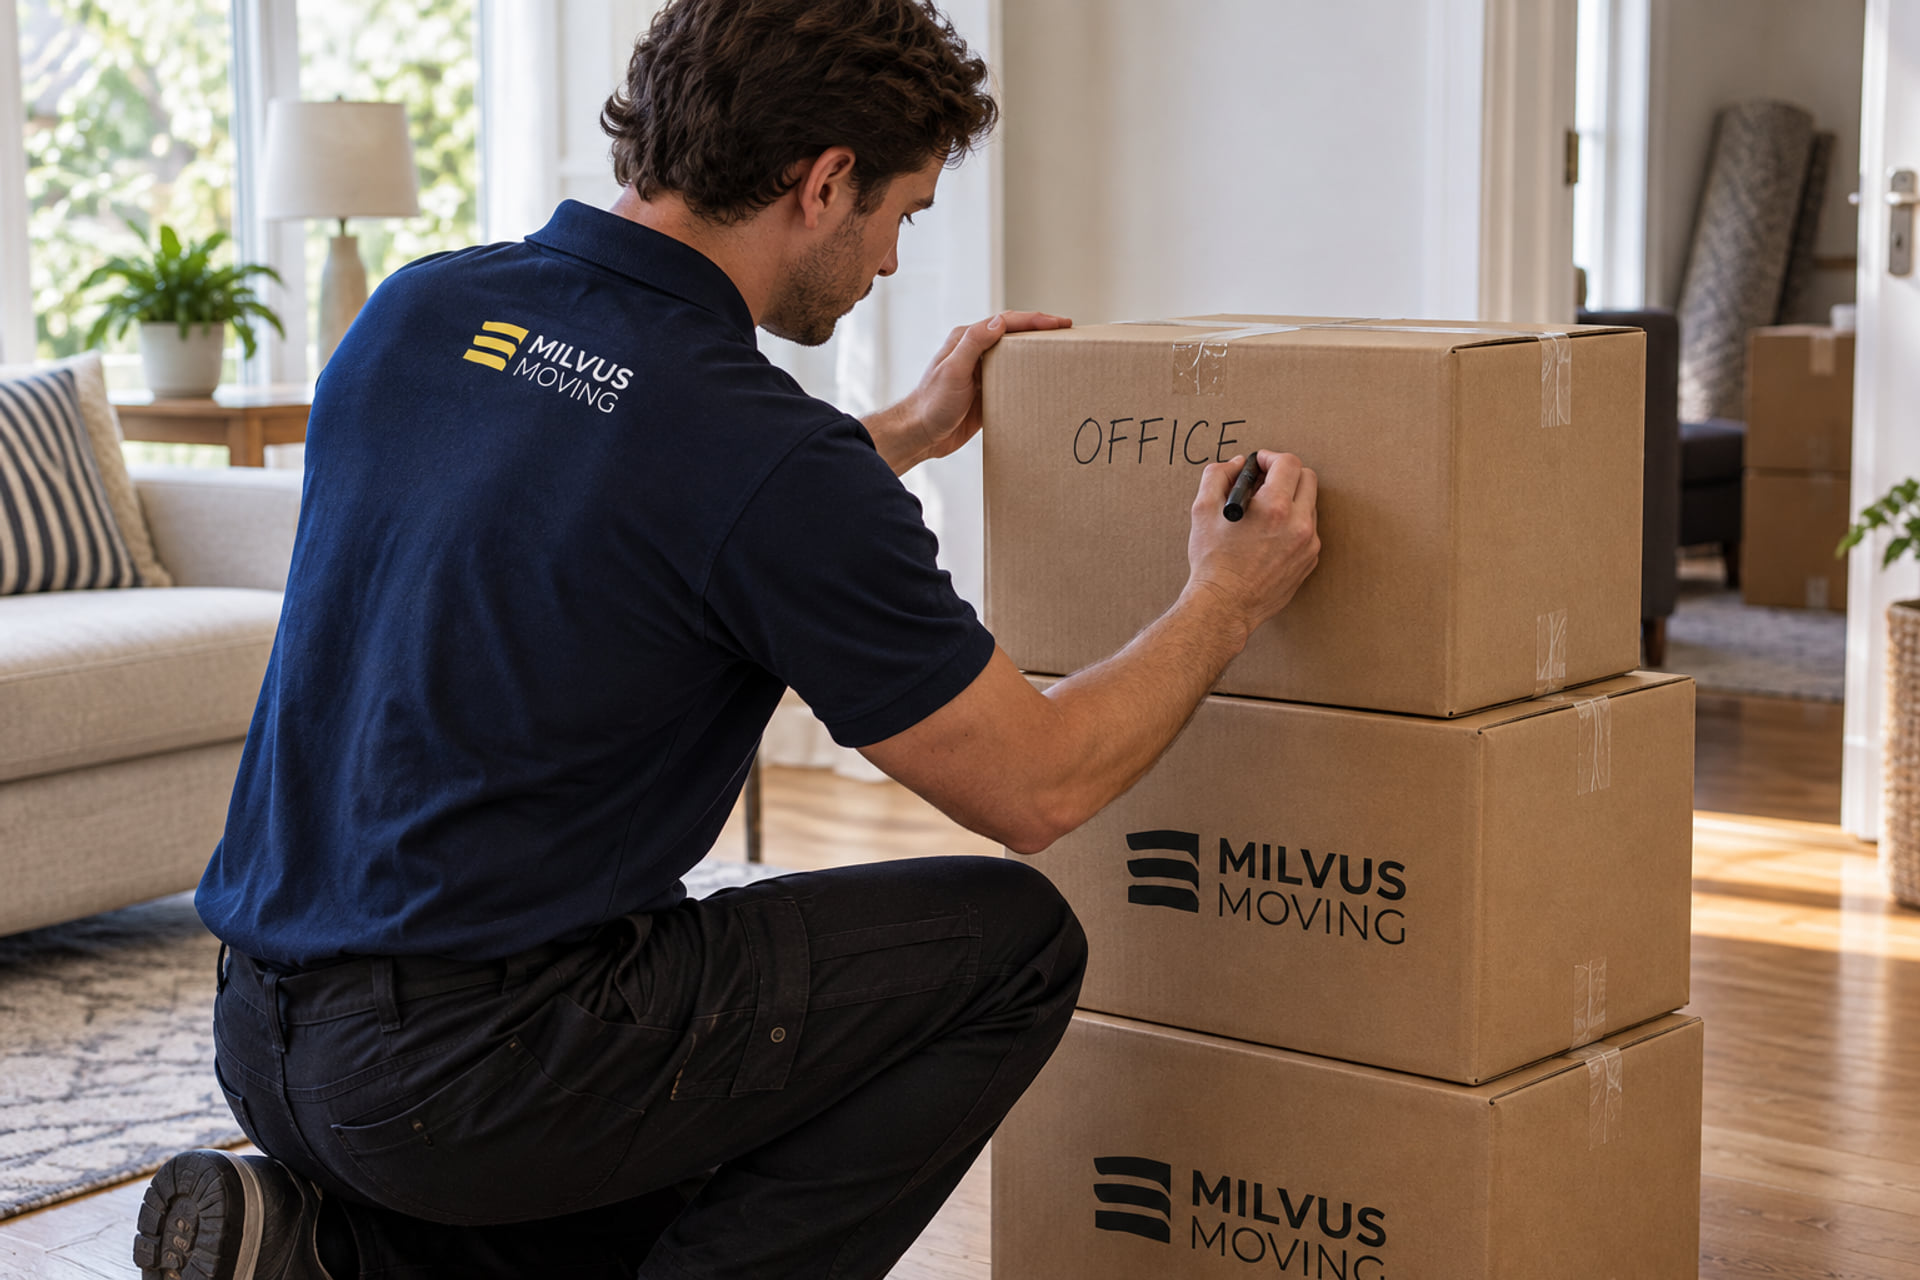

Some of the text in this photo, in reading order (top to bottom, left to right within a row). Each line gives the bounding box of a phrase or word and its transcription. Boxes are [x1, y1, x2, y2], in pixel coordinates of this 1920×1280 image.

[513, 357, 619, 413] MOVING
[528, 335, 634, 390] MILVUS
[1073, 417, 1246, 465] OFFICE
[1219, 837, 1407, 901] MILVUS
[1218, 882, 1406, 945] MOVING
[1192, 1169, 1387, 1248] MILVUS
[1191, 1215, 1385, 1280] MOVING
